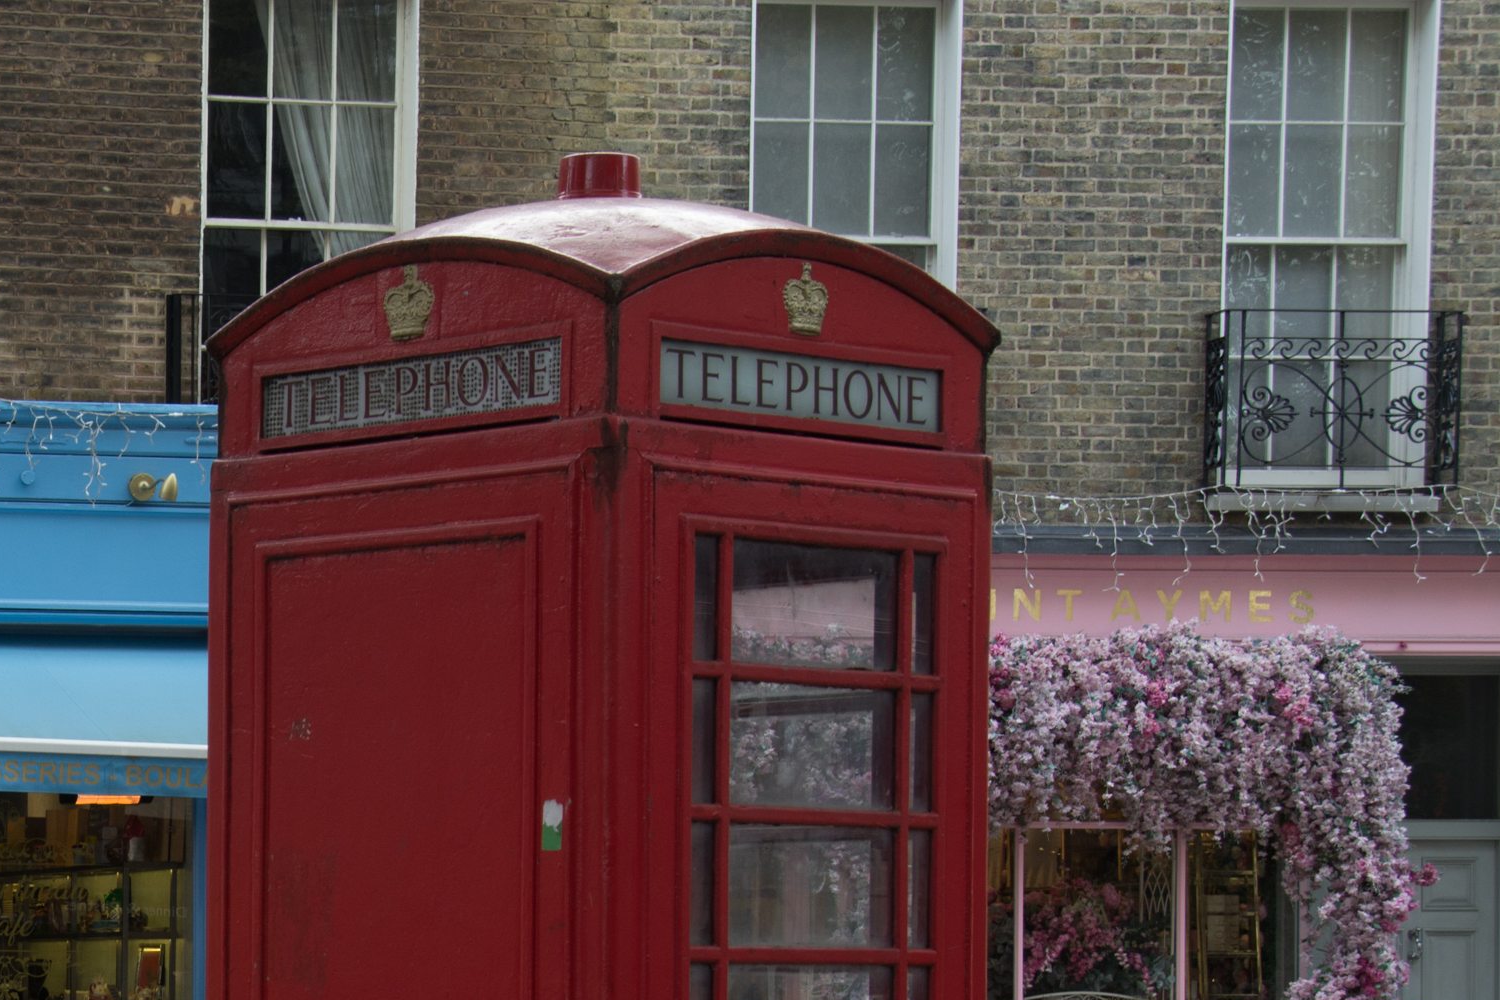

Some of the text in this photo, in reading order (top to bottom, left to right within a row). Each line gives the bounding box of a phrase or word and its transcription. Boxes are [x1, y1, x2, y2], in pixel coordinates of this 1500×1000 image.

[278, 347, 550, 428] TELEPHONE
[665, 348, 927, 425] TELEPHONE
[1110, 589, 1315, 624] AYMES
